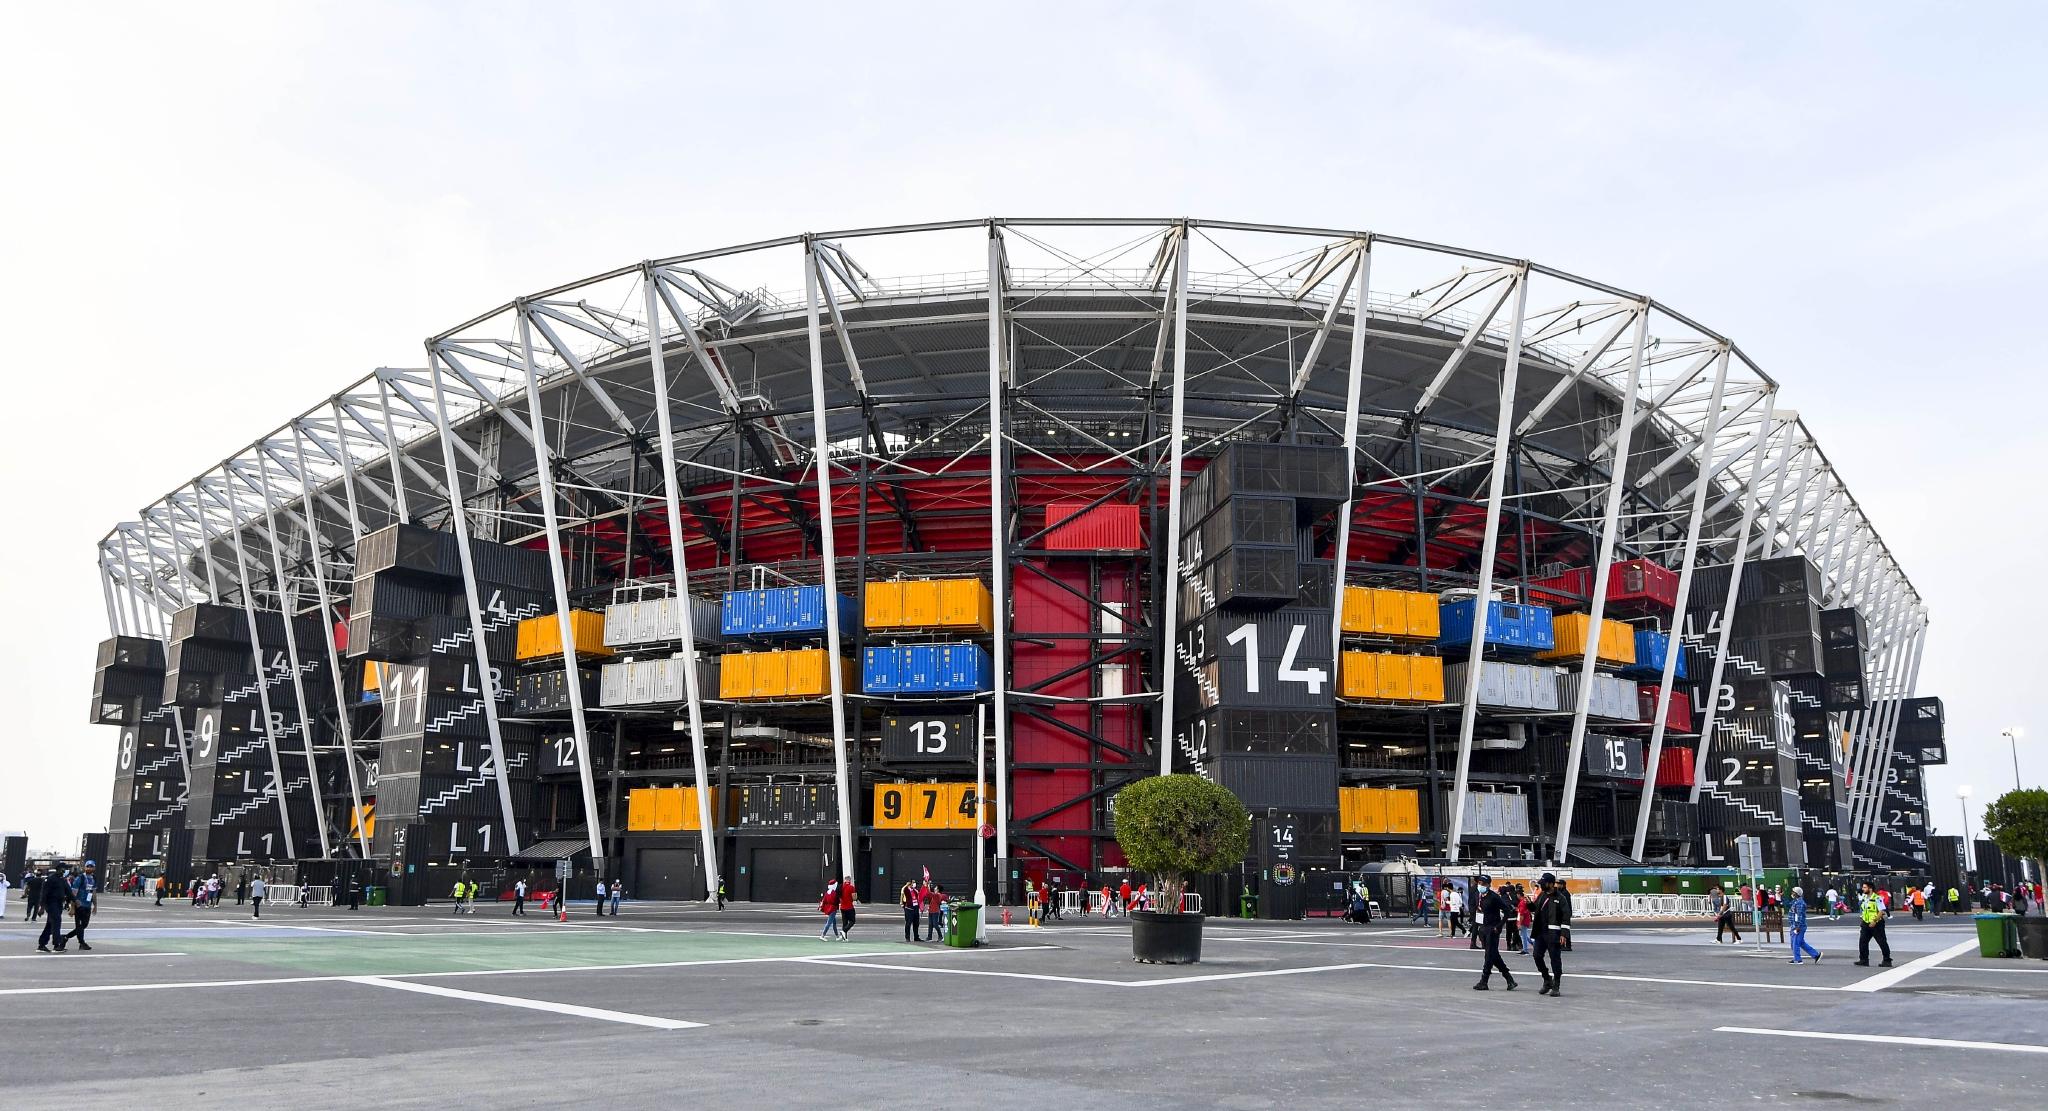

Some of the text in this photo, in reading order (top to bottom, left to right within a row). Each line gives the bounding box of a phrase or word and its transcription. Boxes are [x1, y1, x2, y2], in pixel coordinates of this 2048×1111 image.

[1188, 624, 1206, 666] L3
[1226, 623, 1327, 695] 14
[390, 666, 425, 727] 11
[1693, 684, 1736, 713] L3
[1774, 690, 1793, 745] 16
[121, 732, 133, 770] 8
[200, 714, 214, 758] 9
[554, 737, 575, 767] 12
[908, 720, 947, 754] 13
[1191, 719, 1207, 759] L2
[1828, 720, 1843, 765] 18
[456, 742, 495, 772] L2
[1605, 740, 1627, 771] 15
[243, 770, 278, 794] L2
[237, 831, 273, 855] L1
[394, 830, 405, 843] 12
[450, 822, 491, 852] L1
[1273, 828, 1293, 843] 14
